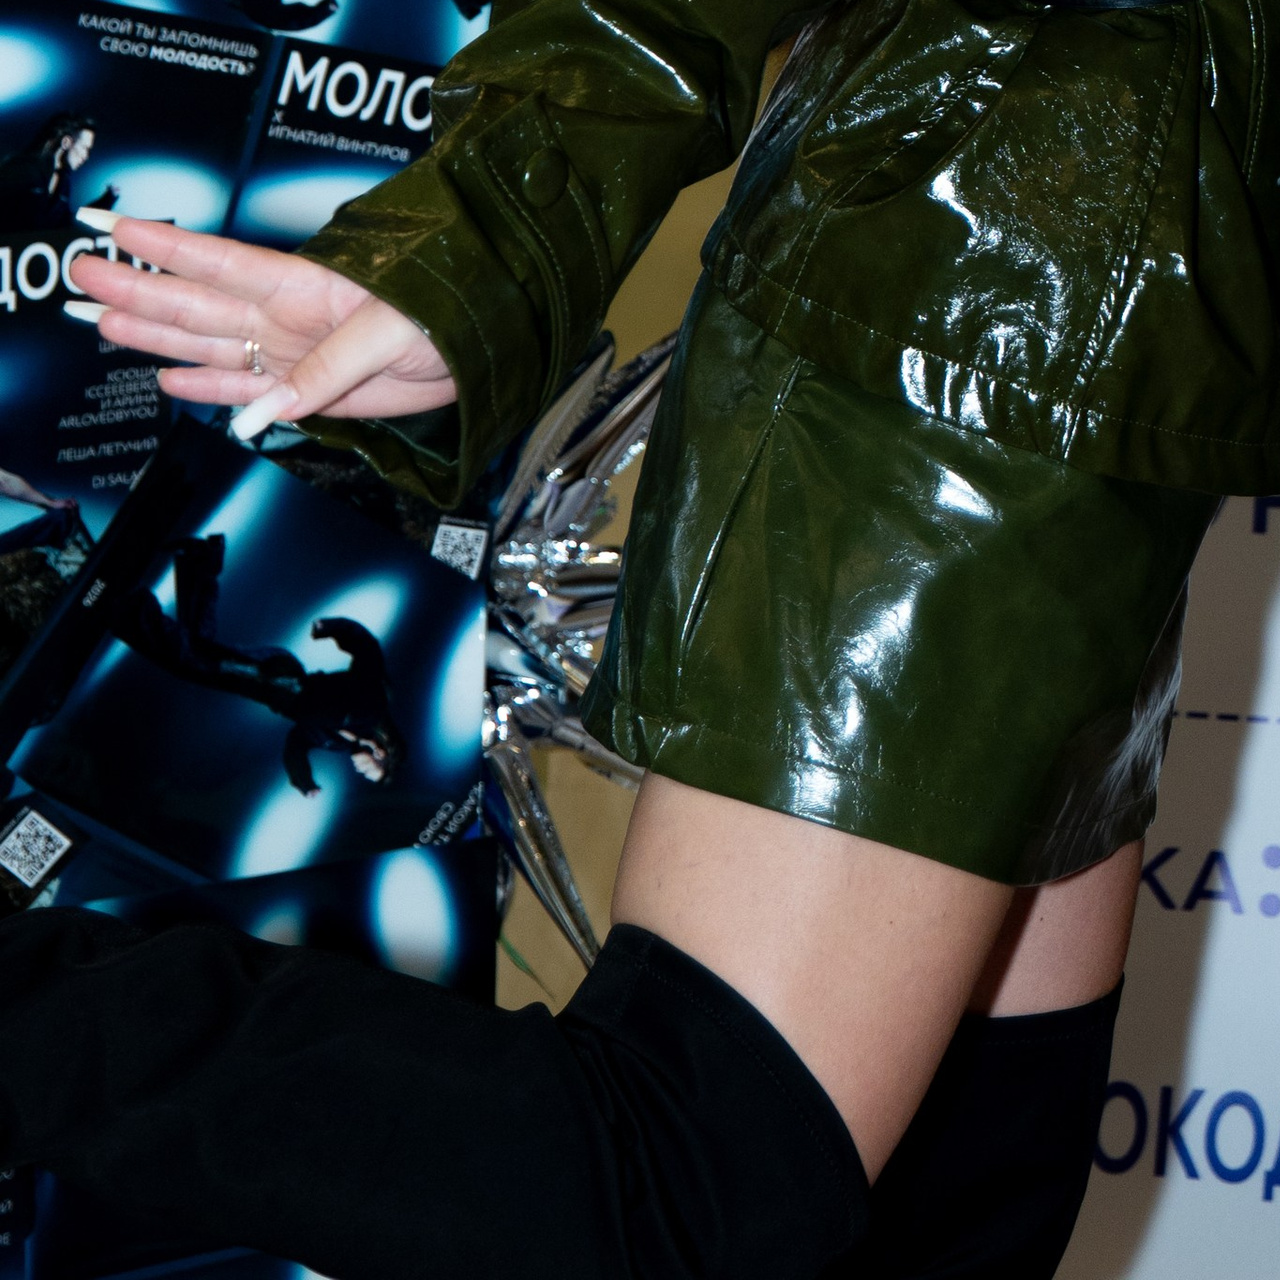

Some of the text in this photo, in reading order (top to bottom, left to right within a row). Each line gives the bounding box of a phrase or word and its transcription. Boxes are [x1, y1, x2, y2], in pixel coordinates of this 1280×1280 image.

[79, 13, 259, 59] КАКОЙ ТЫ ЗАПОМНИШЬ
[100, 36, 256, 76] СВОЮ МОЛОДОСТЬ?
[268, 124, 411, 162] ИГНАТИЙ ВИНТУРОВ
[419, 801, 455, 844] СВОЮ
